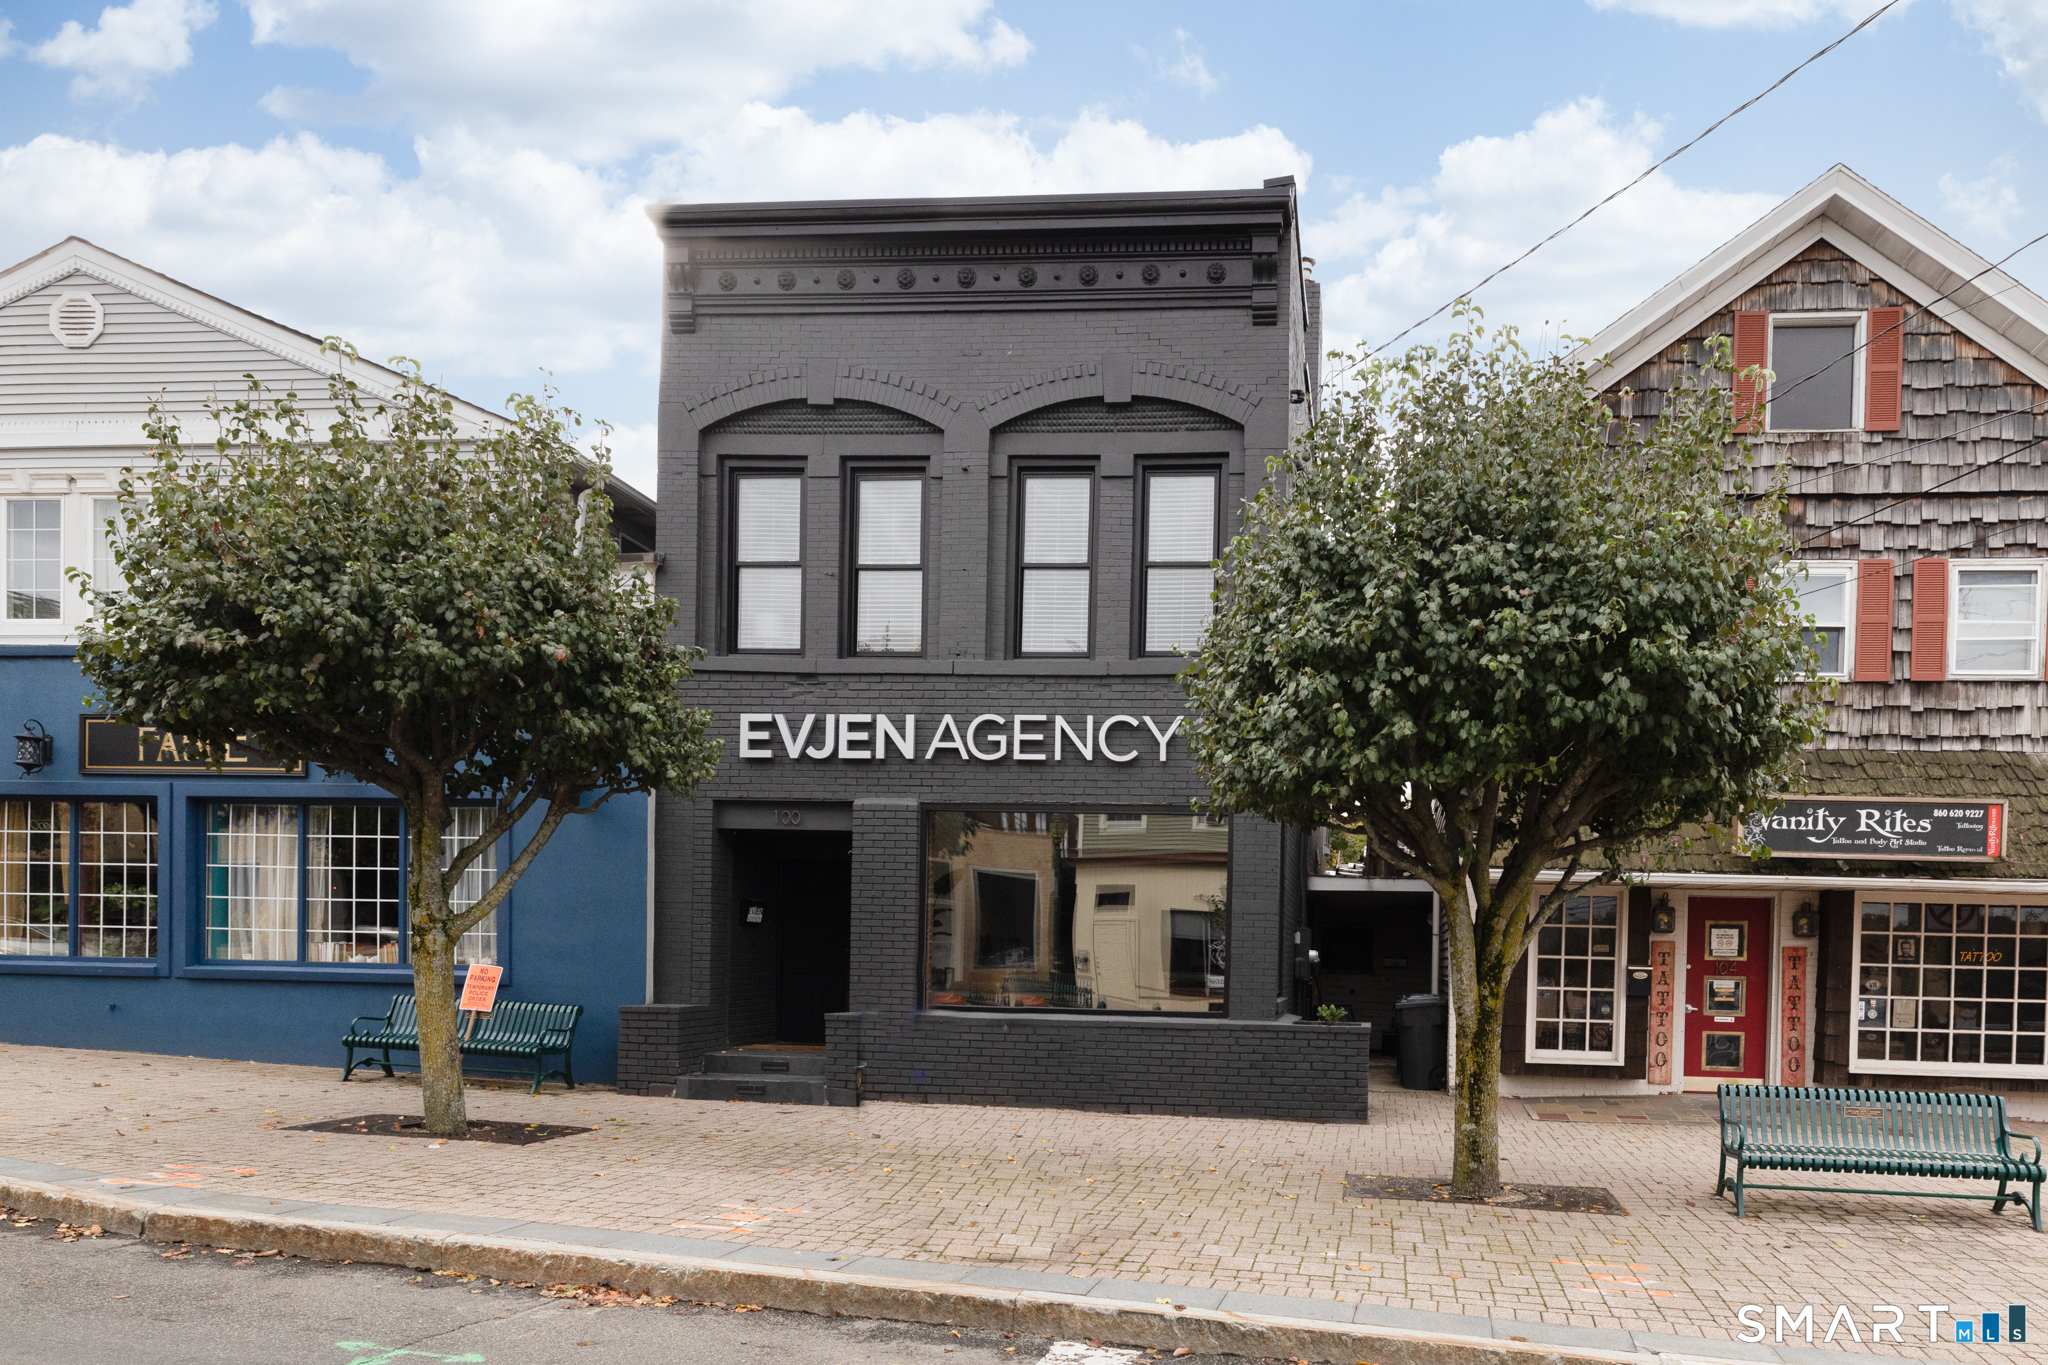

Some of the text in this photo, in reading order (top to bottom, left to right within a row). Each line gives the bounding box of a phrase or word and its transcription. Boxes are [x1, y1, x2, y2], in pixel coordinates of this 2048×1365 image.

[739, 713, 1185, 762] EVJEN AGENCY
[774, 809, 800, 824] 100
[1933, 809, 1984, 818] 860 620 9227
[1856, 808, 1932, 838] Rites
[1956, 822, 1983, 831] Tattooing
[1831, 837, 1852, 845] Tattoo
[1869, 838, 1888, 848] Body
[1889, 837, 1903, 848] Art
[1905, 838, 1927, 846] Studio
[1960, 951, 2002, 962] TATTOO
[1715, 961, 1738, 975] 104
